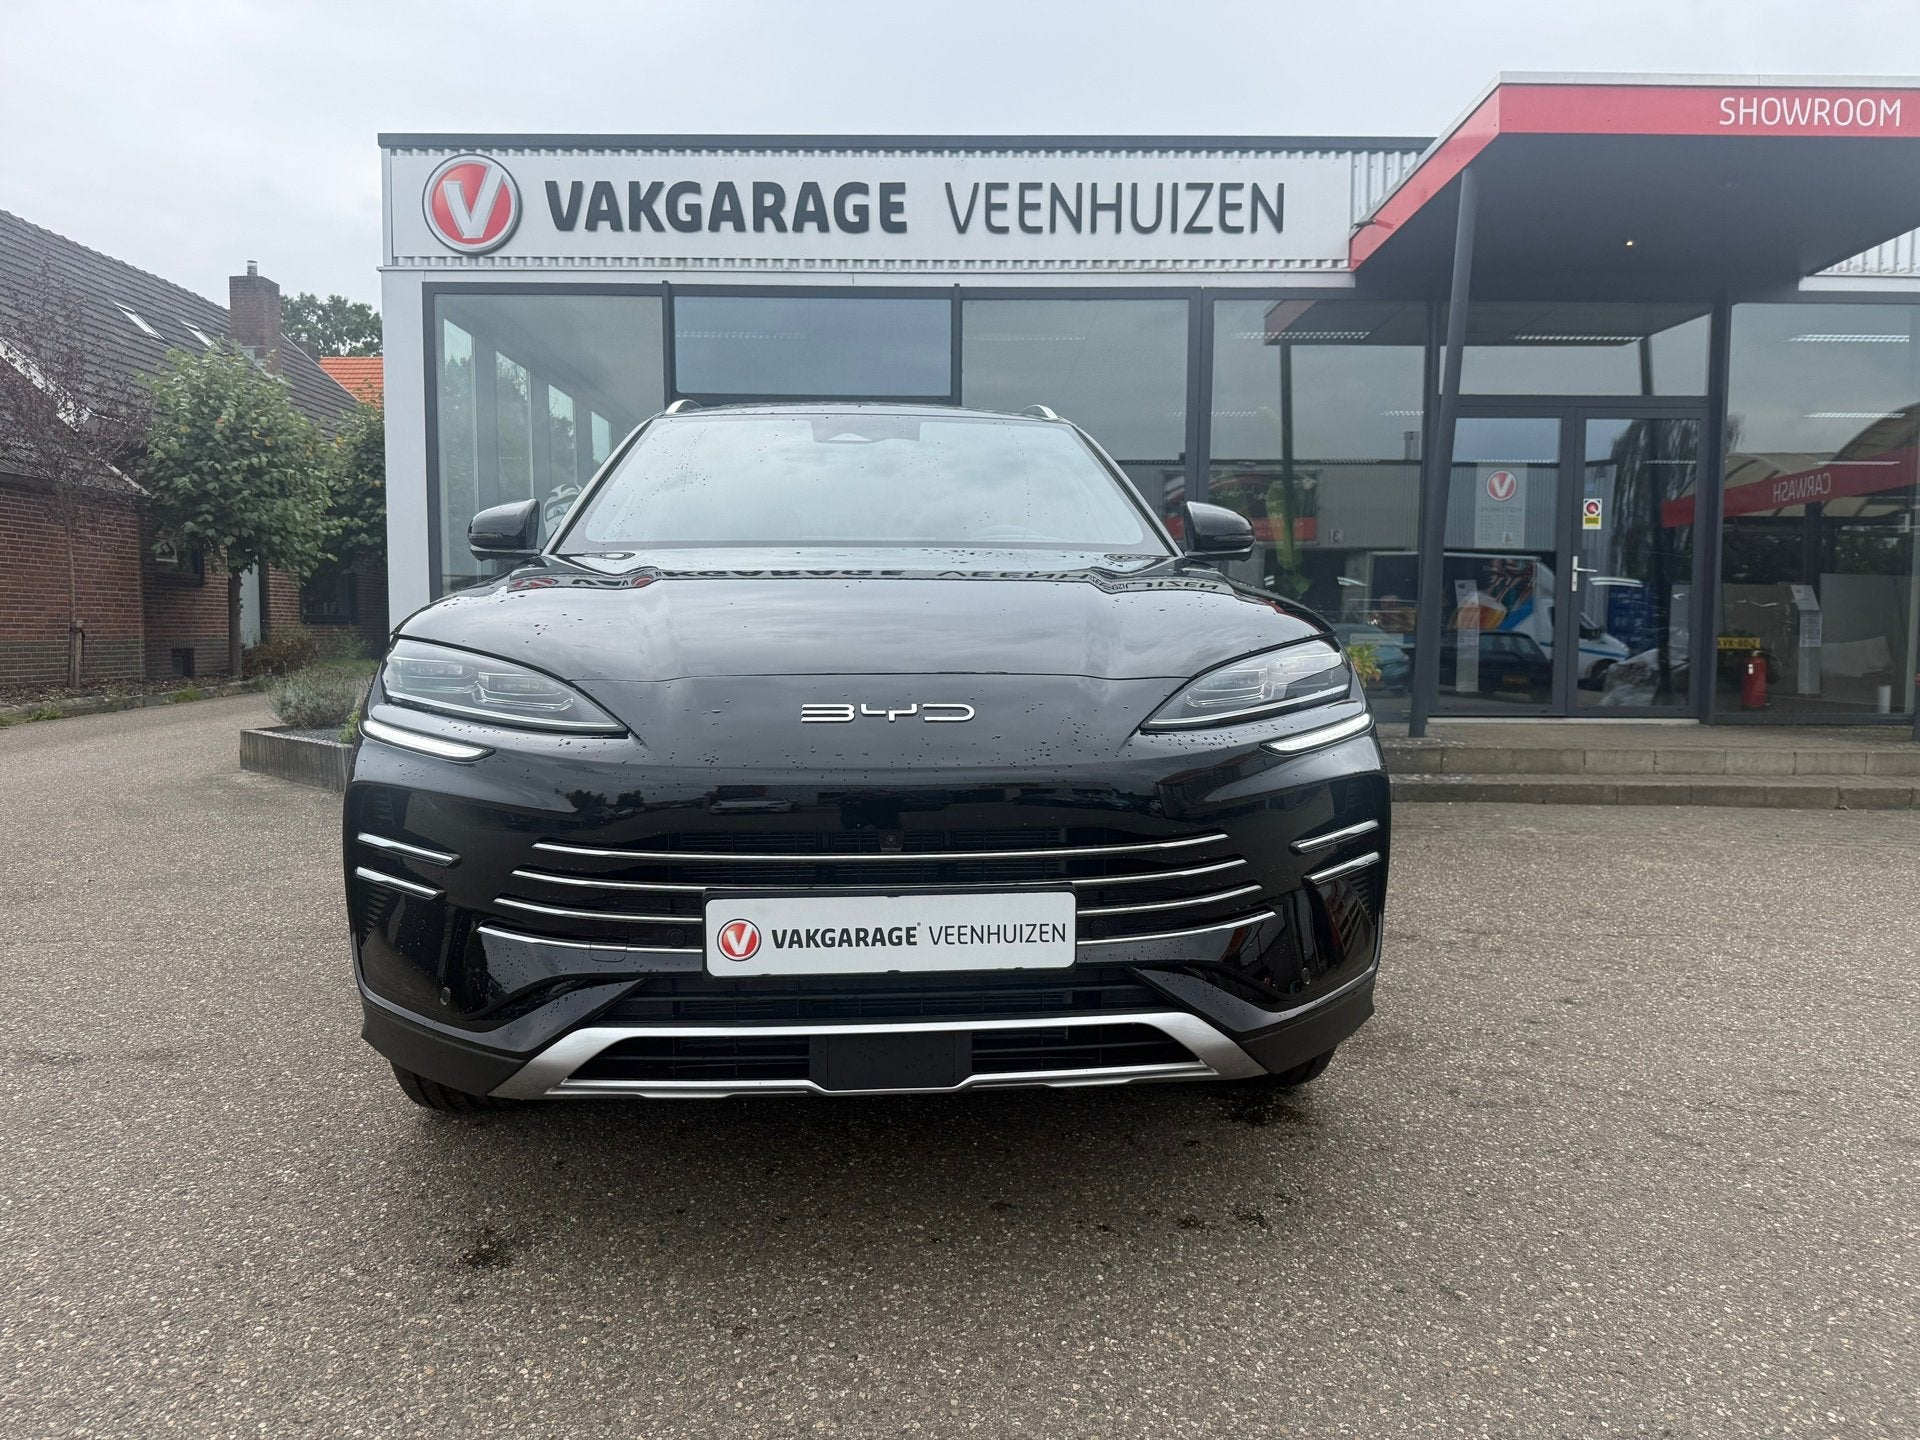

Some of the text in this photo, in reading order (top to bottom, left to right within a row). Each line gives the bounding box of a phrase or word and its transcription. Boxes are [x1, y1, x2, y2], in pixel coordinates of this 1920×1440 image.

[1719, 97, 1901, 127] SHOWROOM
[544, 180, 907, 233] VAKGARAGE
[945, 181, 1286, 233] VEENHUIZEN
[801, 703, 975, 723] BYD
[771, 926, 917, 949] VAKGARAGE
[928, 923, 1067, 945] VEENHUIZEN
